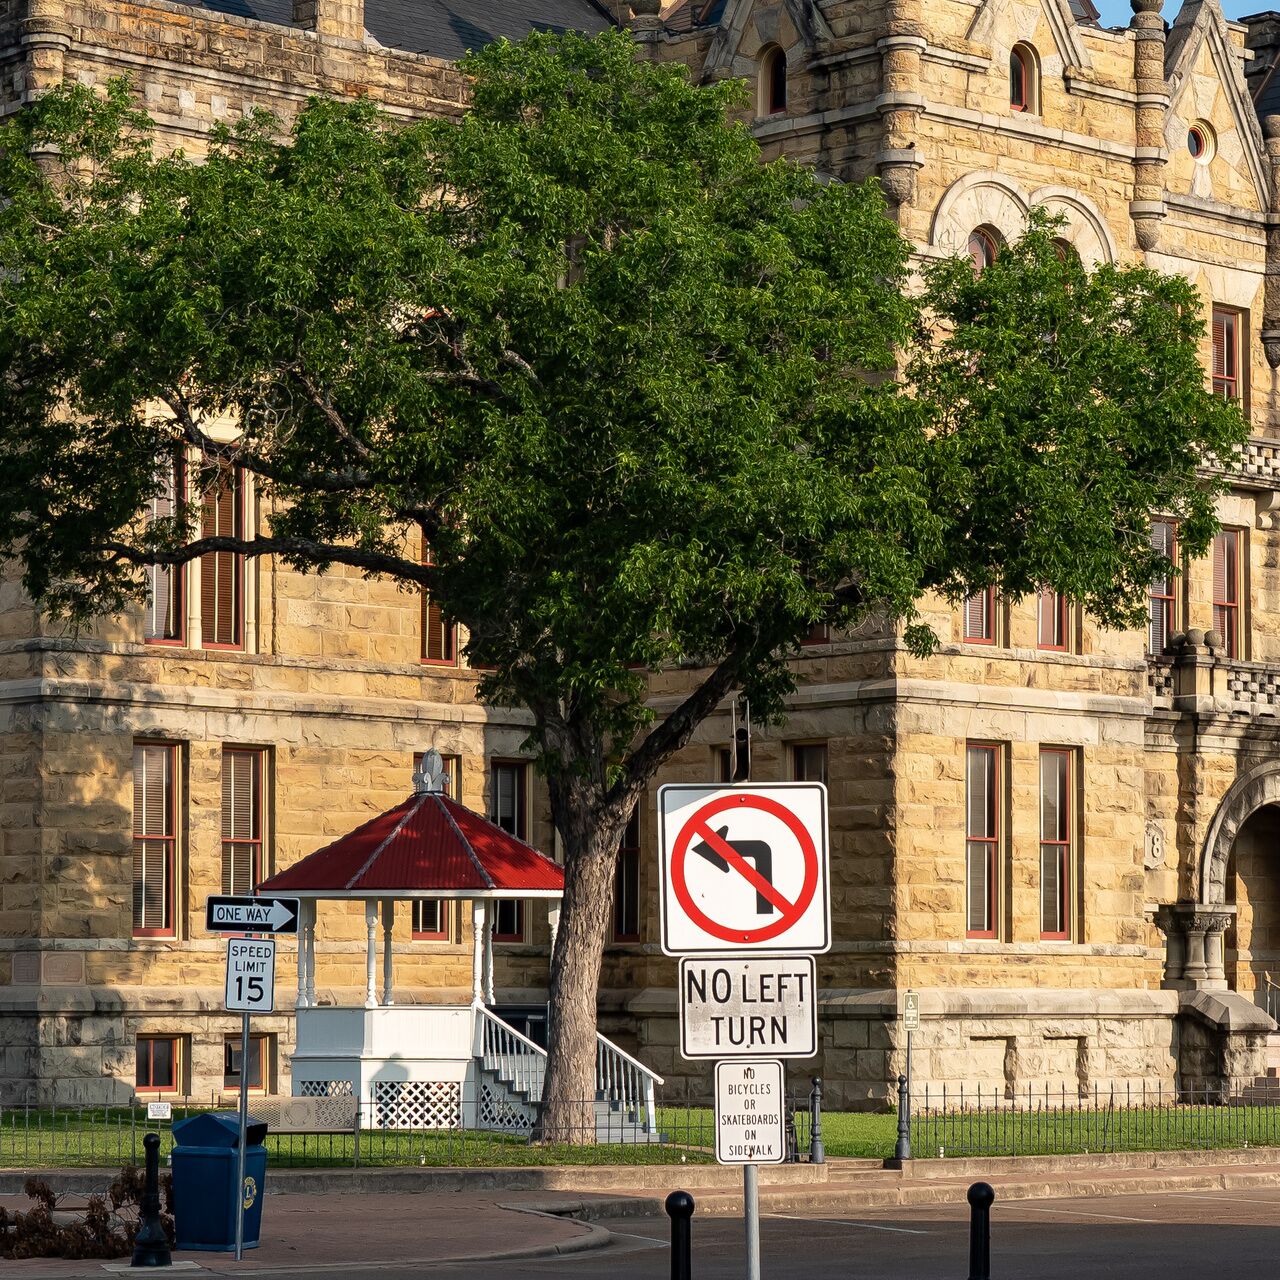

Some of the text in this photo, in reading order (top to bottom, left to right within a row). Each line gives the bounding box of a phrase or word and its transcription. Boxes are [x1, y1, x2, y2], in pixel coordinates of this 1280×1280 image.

[216, 907, 271, 922] ONE WAY
[232, 945, 272, 959] SPEED
[235, 961, 267, 973] LIMIT
[236, 976, 264, 1002] 15
[687, 968, 808, 1004] NO LEFT
[710, 1015, 787, 1046] TURN
[743, 1068, 755, 1080] NO
[728, 1084, 771, 1095] BICYCLES
[744, 1099, 756, 1110] OR
[721, 1114, 779, 1126] SKATEBOARDS
[744, 1129, 757, 1141] ON
[728, 1145, 773, 1156] SIDEWALK
